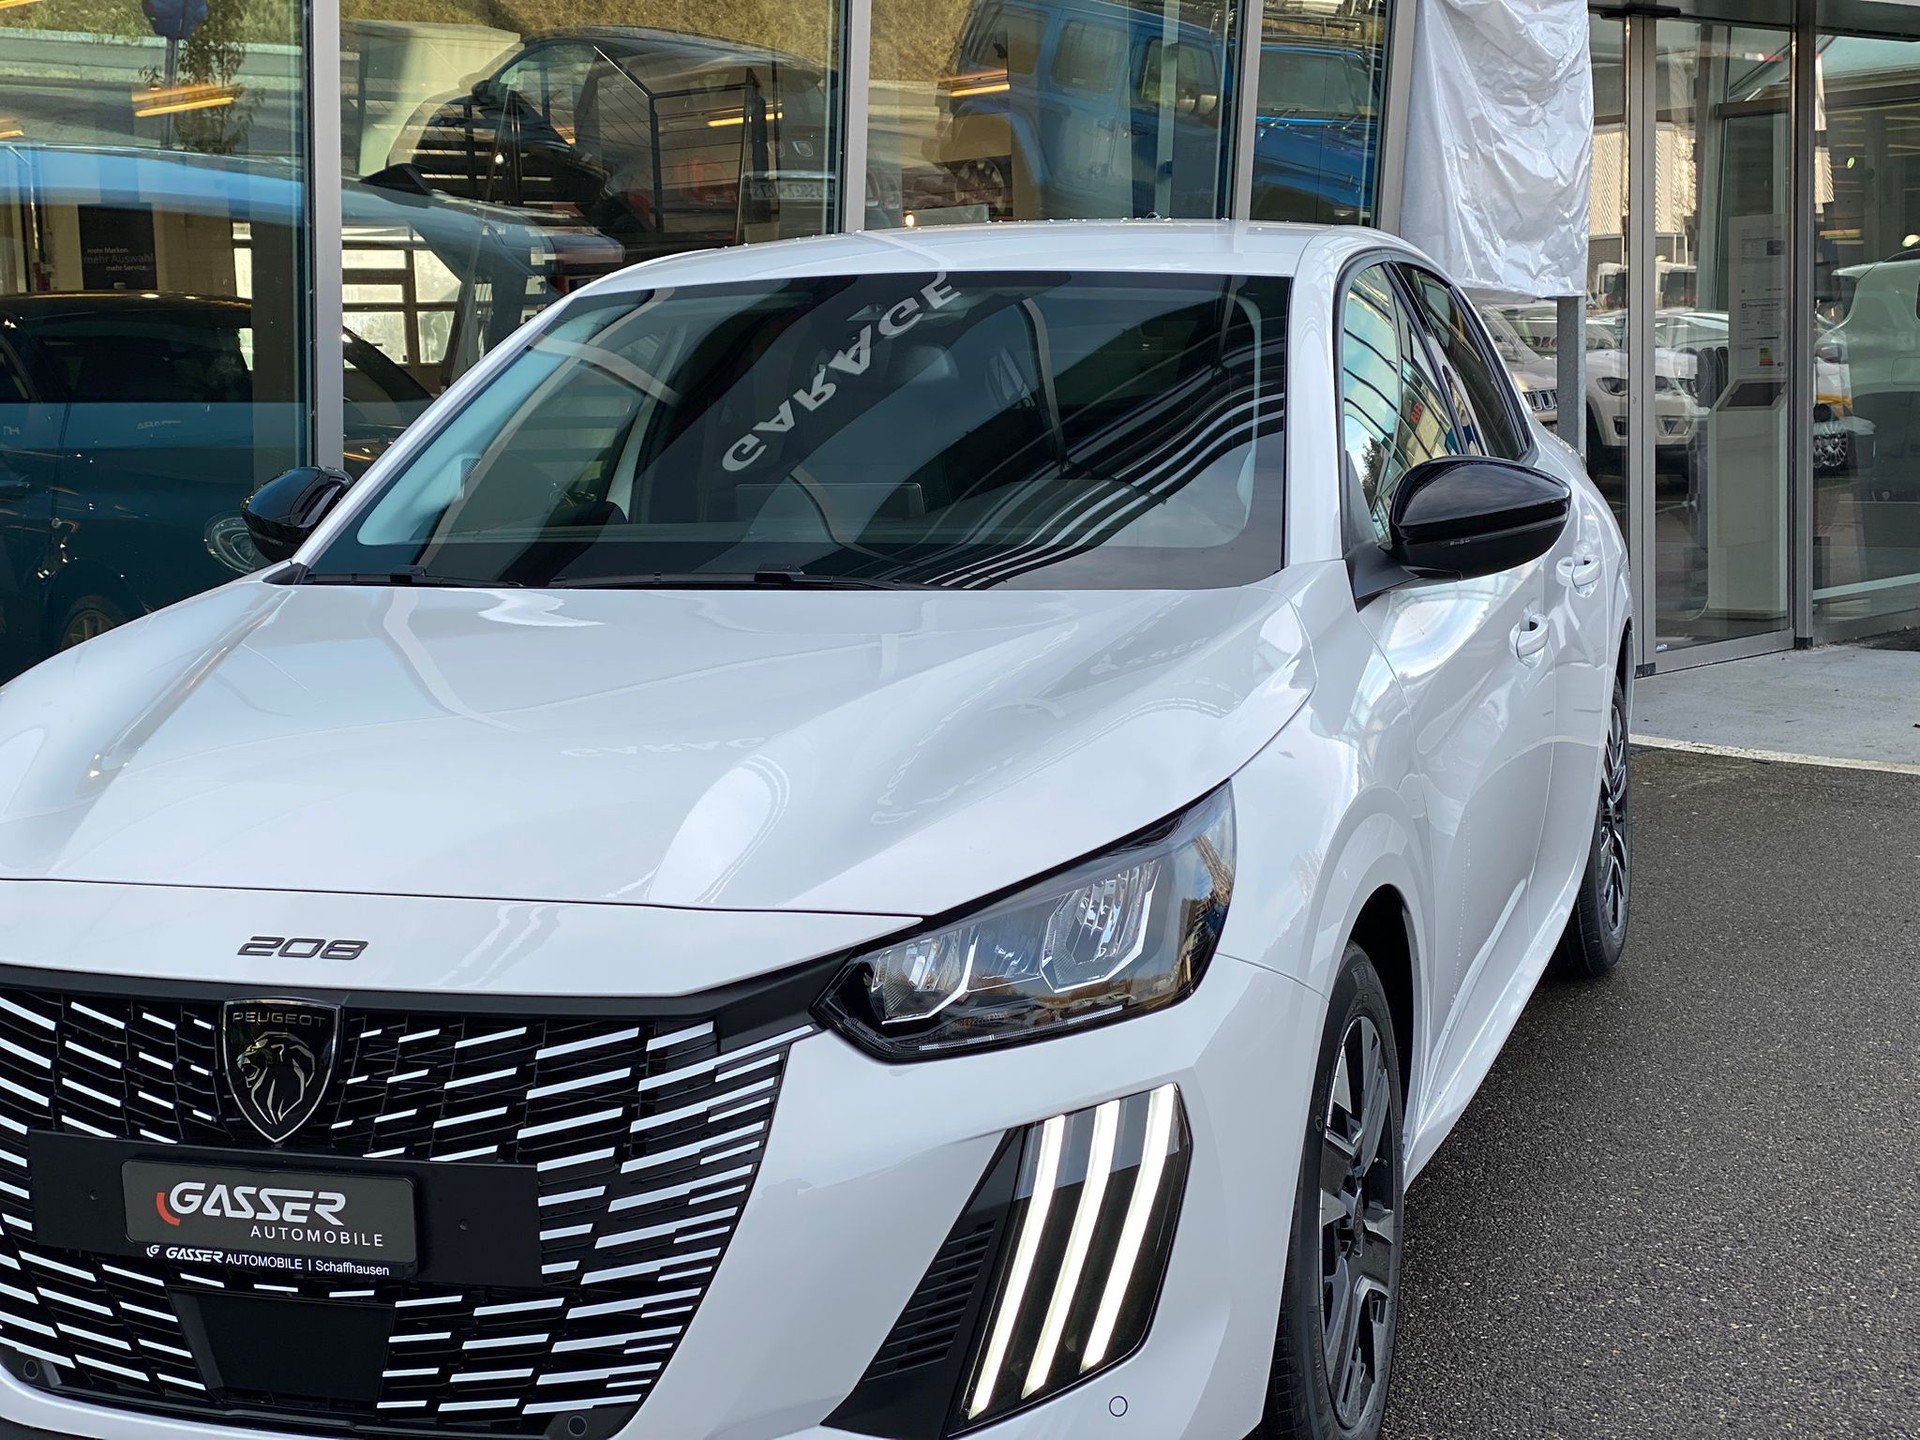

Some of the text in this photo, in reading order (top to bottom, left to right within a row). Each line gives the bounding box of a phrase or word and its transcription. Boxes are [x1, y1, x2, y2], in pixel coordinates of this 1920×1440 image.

[110, 253, 154, 264] Auswahl
[237, 935, 369, 961] 208
[232, 1011, 327, 1028] PEUGEOT
[169, 1181, 346, 1226] GASSER
[250, 1225, 384, 1248] AUTOMOBILE
[165, 1246, 224, 1264] GASSER
[225, 1253, 303, 1270] AUTOMOBILE
[315, 1259, 390, 1277] Schaffhausen
